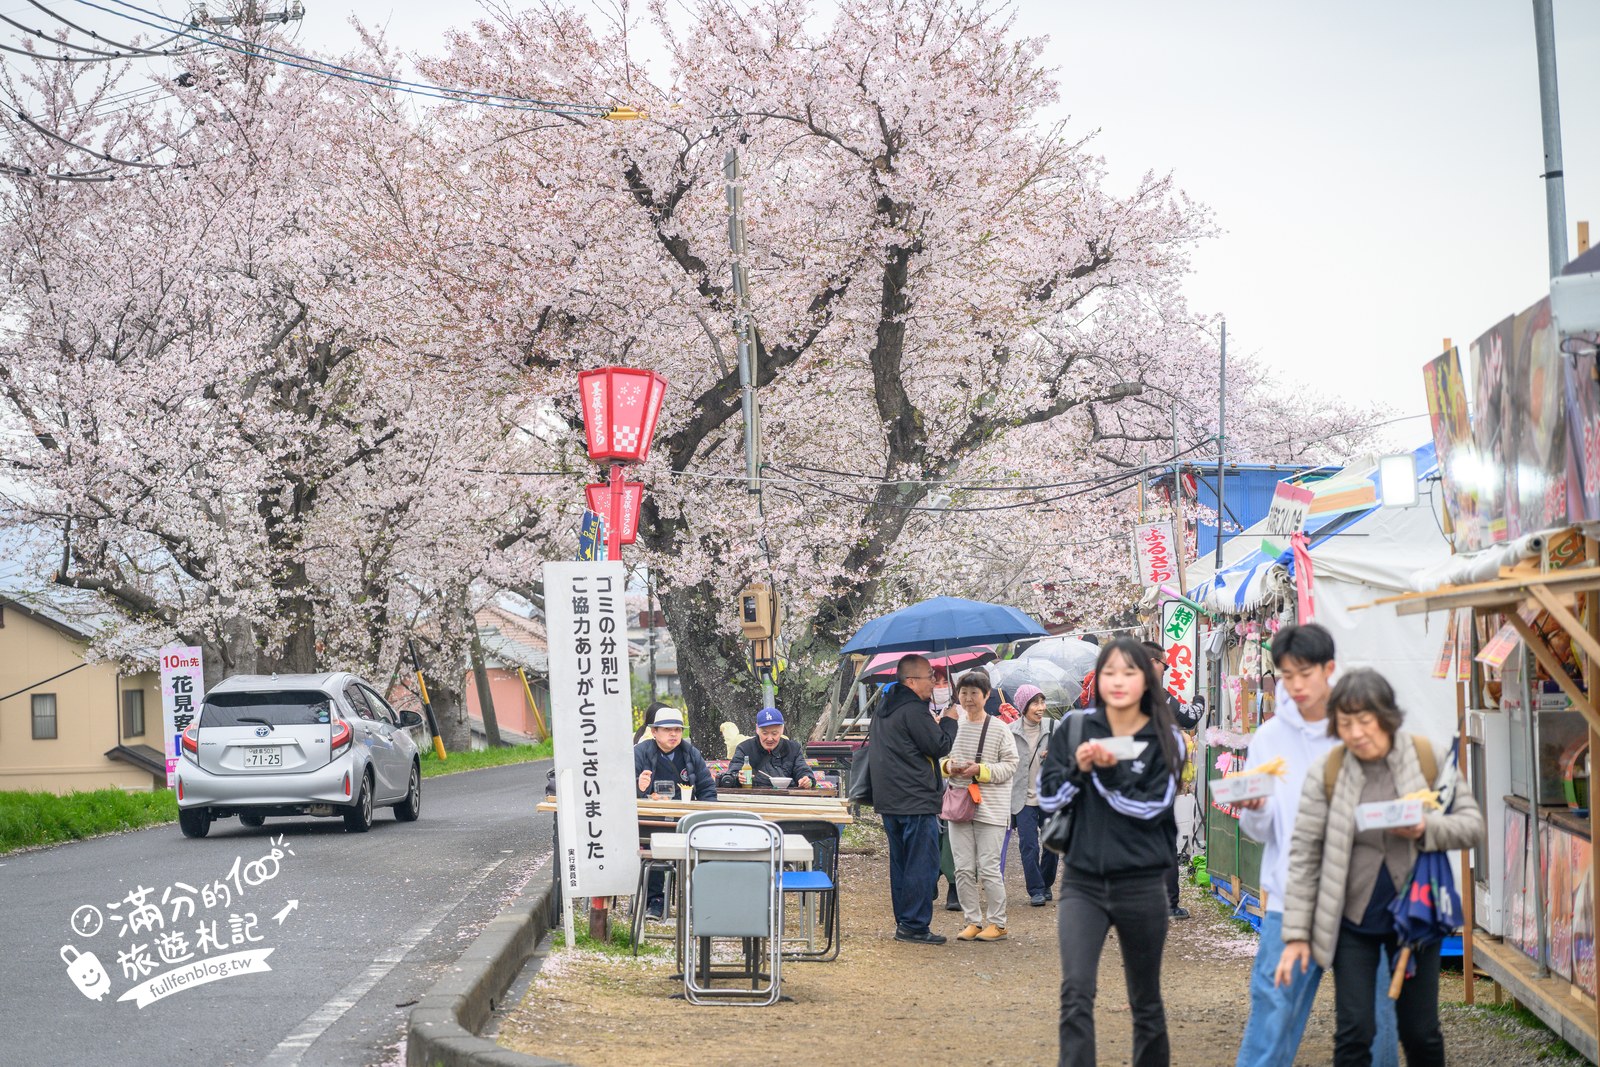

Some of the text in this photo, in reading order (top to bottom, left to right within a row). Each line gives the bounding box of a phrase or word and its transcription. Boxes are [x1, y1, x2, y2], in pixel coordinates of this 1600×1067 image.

[596, 576, 619, 695] ゴミの分別に
[1166, 606, 1193, 639] 特大
[163, 655, 199, 668] 10m先
[1166, 642, 1193, 704] ねぎ
[572, 576, 605, 871] ご協力ありがとうございました。
[252, 754, 280, 765] 71-25
